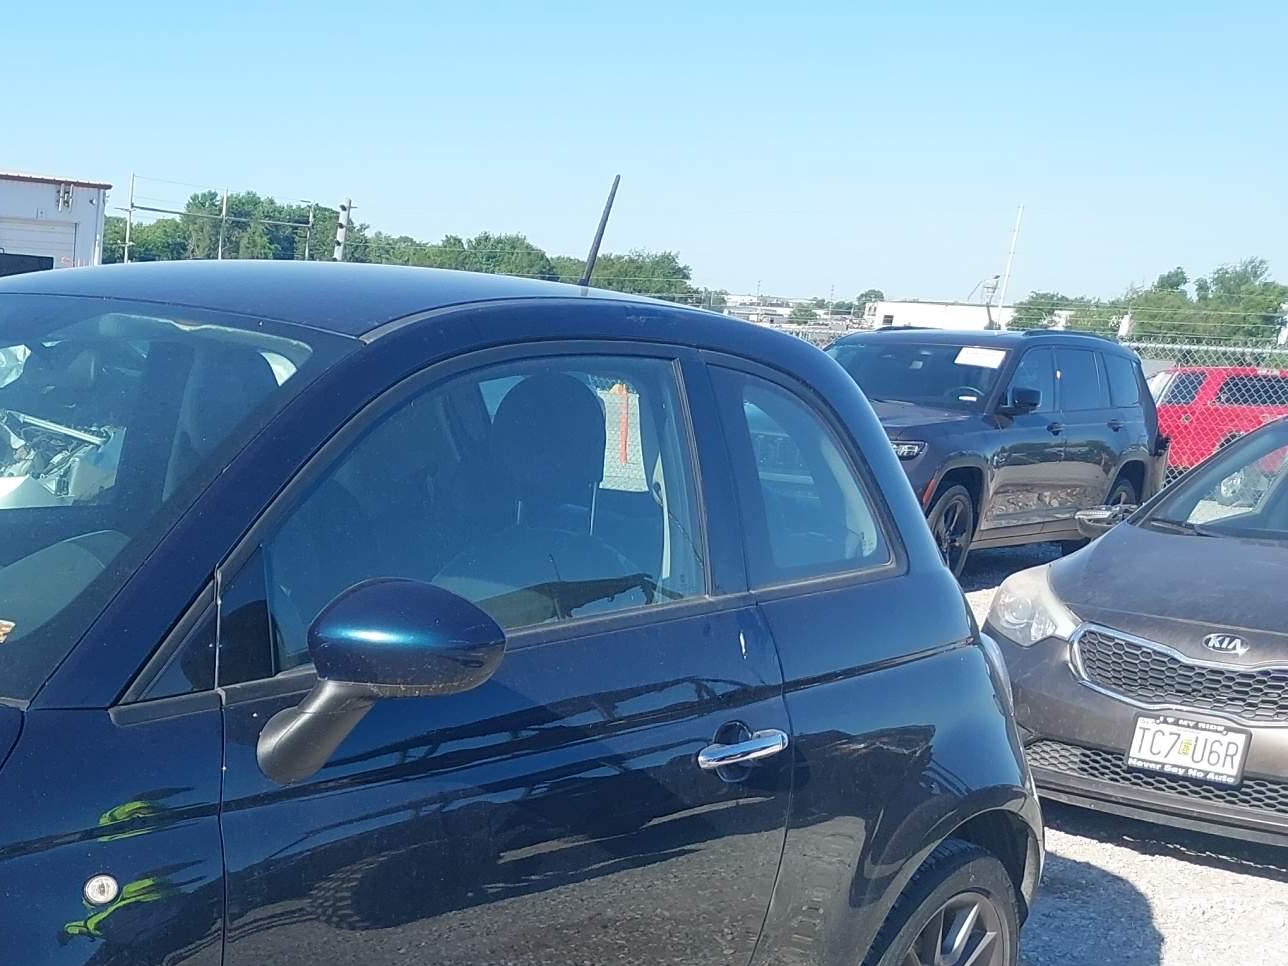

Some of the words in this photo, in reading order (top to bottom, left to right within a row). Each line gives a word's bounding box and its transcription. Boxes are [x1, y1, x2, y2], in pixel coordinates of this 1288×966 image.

[1208, 636, 1242, 650] KIA
[1178, 719, 1197, 727] MY
[1137, 726, 1181, 759] TC7
[1191, 735, 1239, 770] U6R
[1128, 757, 1162, 771] Never
[1164, 764, 1186, 776] Say
[1187, 768, 1205, 778] No
[1206, 772, 1236, 784] Auto
